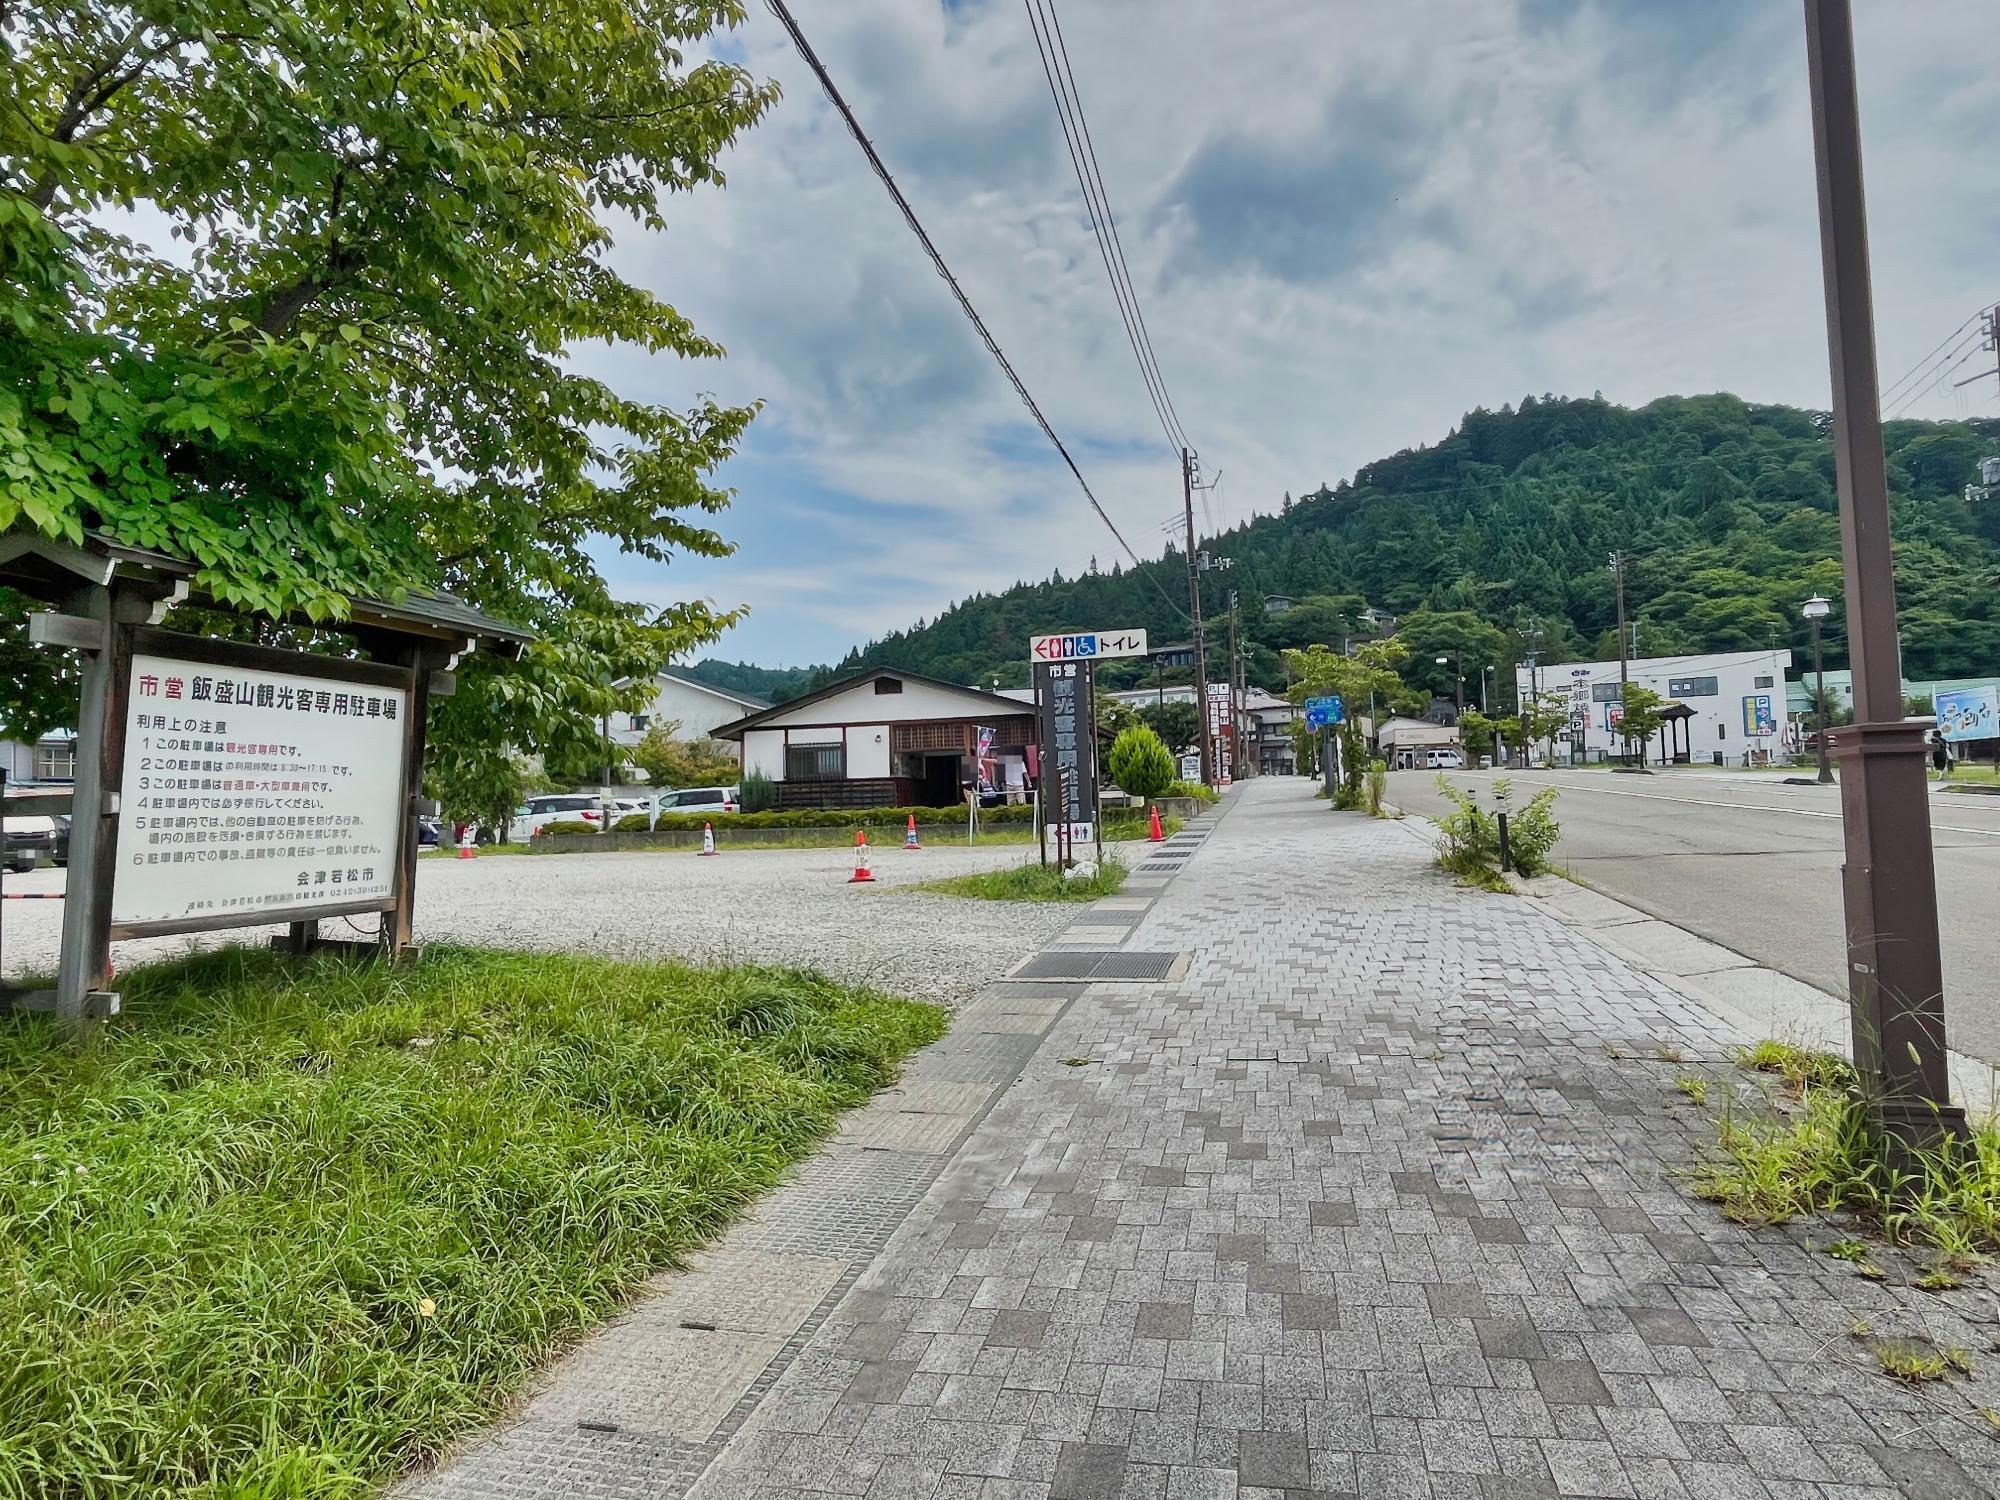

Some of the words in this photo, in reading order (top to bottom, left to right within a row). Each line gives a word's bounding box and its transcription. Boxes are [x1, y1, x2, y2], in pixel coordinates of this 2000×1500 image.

[1100, 636, 1140, 652] トイレ
[1049, 664, 1077, 678] 市営
[139, 675, 184, 700] 市営
[192, 676, 397, 720] 飯盛山観光客専用駐車場
[137, 715, 227, 734] 利用上の注意
[143, 737, 150, 749] 1
[140, 758, 151, 770] 2
[139, 777, 150, 790] 3
[137, 797, 148, 809] 4
[135, 816, 146, 829] 5
[133, 853, 143, 866] 6
[297, 867, 375, 886] 会津若松市
